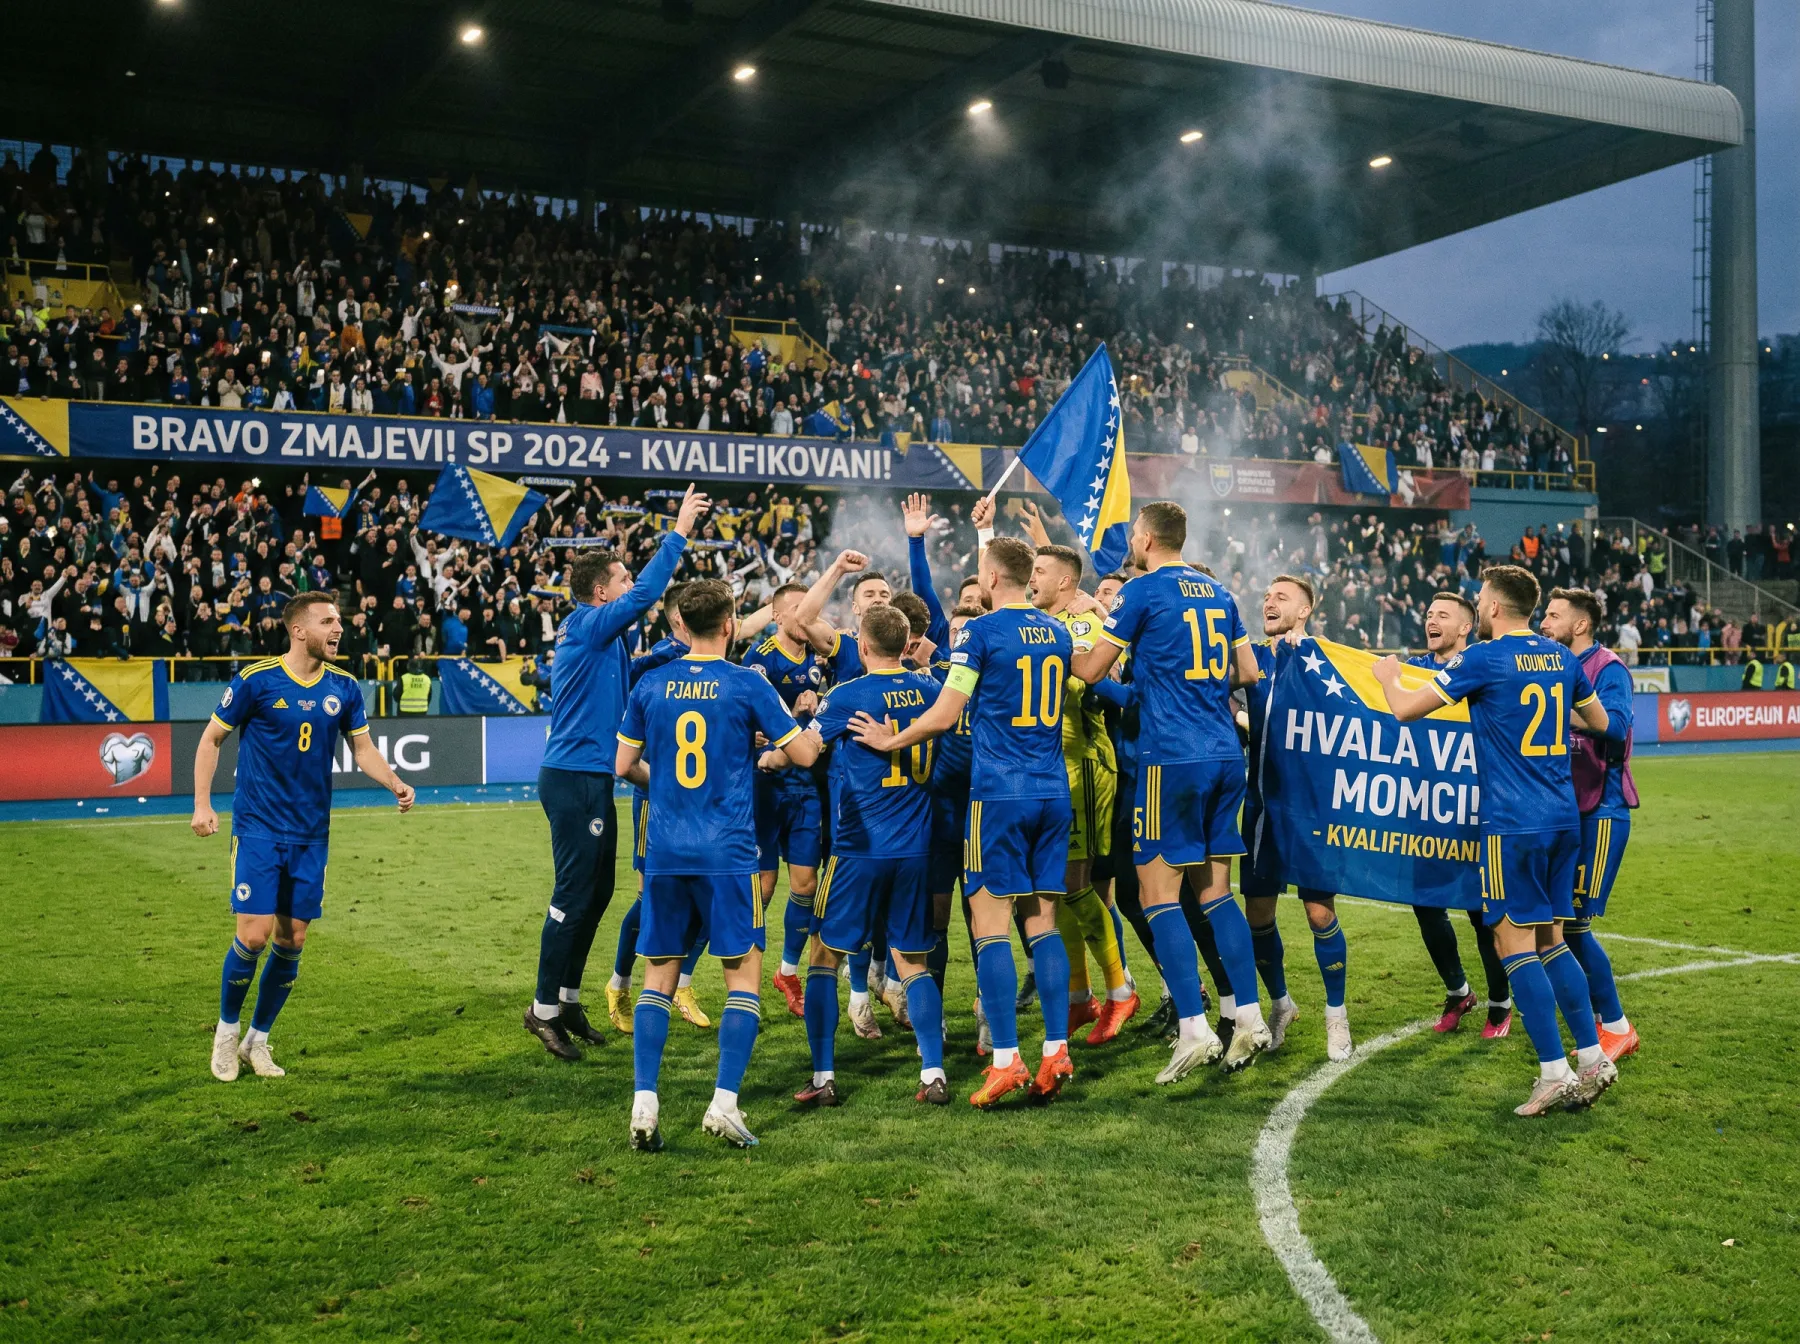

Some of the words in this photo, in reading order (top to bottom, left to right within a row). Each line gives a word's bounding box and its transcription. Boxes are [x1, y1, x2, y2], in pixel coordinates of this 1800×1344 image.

[132, 415, 269, 456] BRAVO
[280, 422, 456, 463] ZMAJEVI!
[467, 430, 513, 464] SP
[523, 433, 610, 469] 2024
[641, 438, 892, 481] KVALIFIKOVANI!
[1018, 626, 1057, 645] VISCA
[1182, 607, 1229, 681] 15
[665, 679, 720, 700] PJANIĆ
[882, 688, 926, 709] VISCA
[1011, 654, 1064, 728] 10
[298, 722, 313, 752] 8
[1285, 708, 1419, 768] HVALA
[1520, 682, 1567, 757] 21
[675, 710, 707, 790] 8
[1331, 768, 1481, 826] MOMCI!
[1133, 807, 1143, 838] 5
[1326, 823, 1481, 863] KVALIFIKOVANI
[1573, 864, 1587, 895] 1
